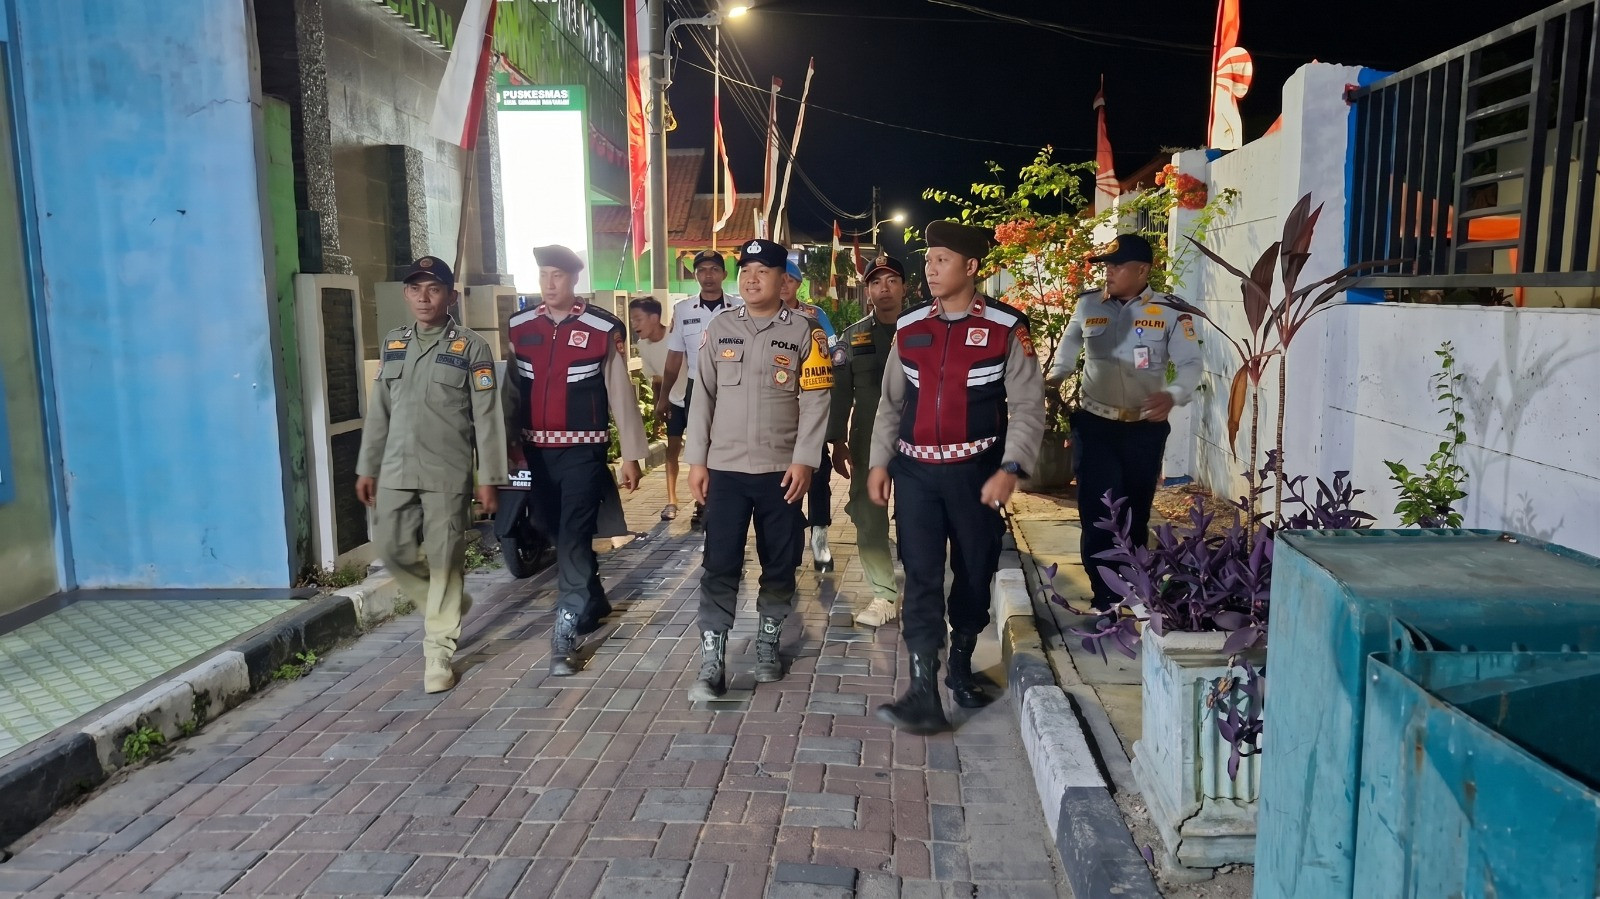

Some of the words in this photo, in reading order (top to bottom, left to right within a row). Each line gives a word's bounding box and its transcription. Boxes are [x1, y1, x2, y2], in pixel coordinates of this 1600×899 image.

[503, 89, 568, 100] PUSKESMAS
[1134, 319, 1165, 329] POLRI
[771, 340, 799, 353] POLRI
